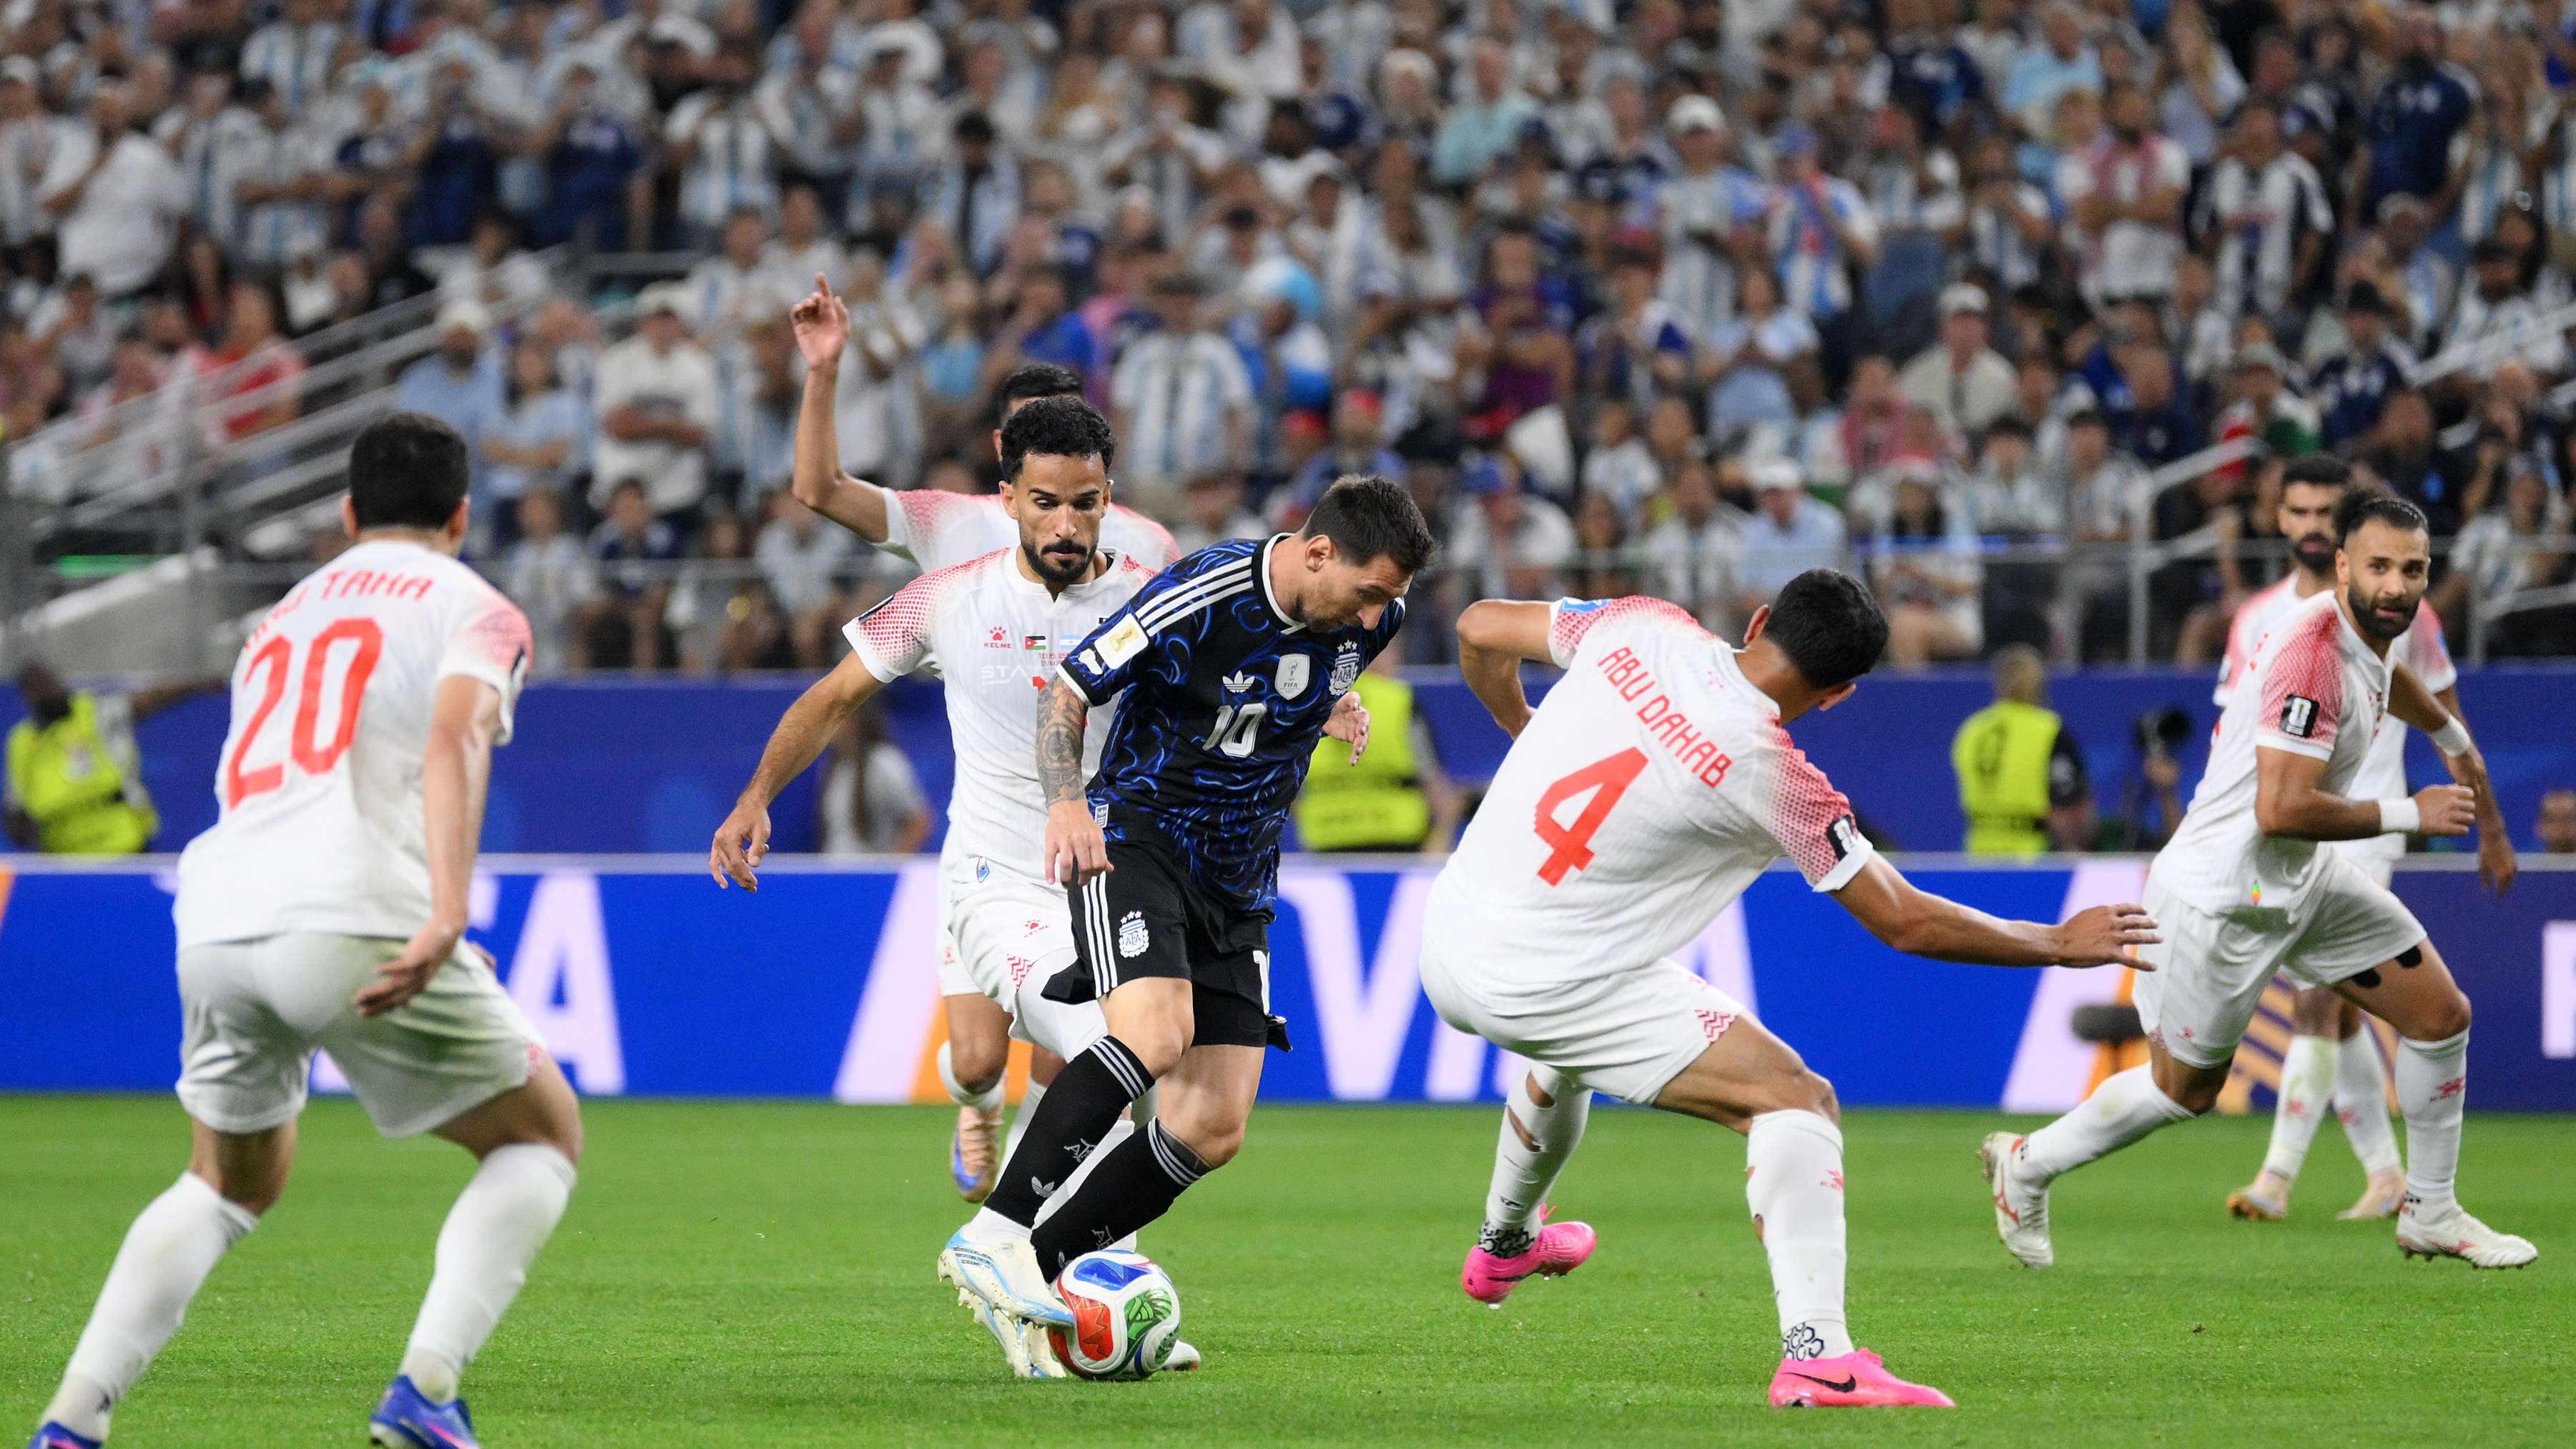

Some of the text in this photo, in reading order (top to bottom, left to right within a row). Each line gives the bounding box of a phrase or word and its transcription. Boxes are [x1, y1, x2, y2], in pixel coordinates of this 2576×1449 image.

[321, 571, 433, 601] TAHA
[226, 617, 384, 812] 20
[1201, 702, 1268, 758] 10
[1596, 646, 1734, 788] ABU DAHAB
[1533, 746, 1650, 888] 4
